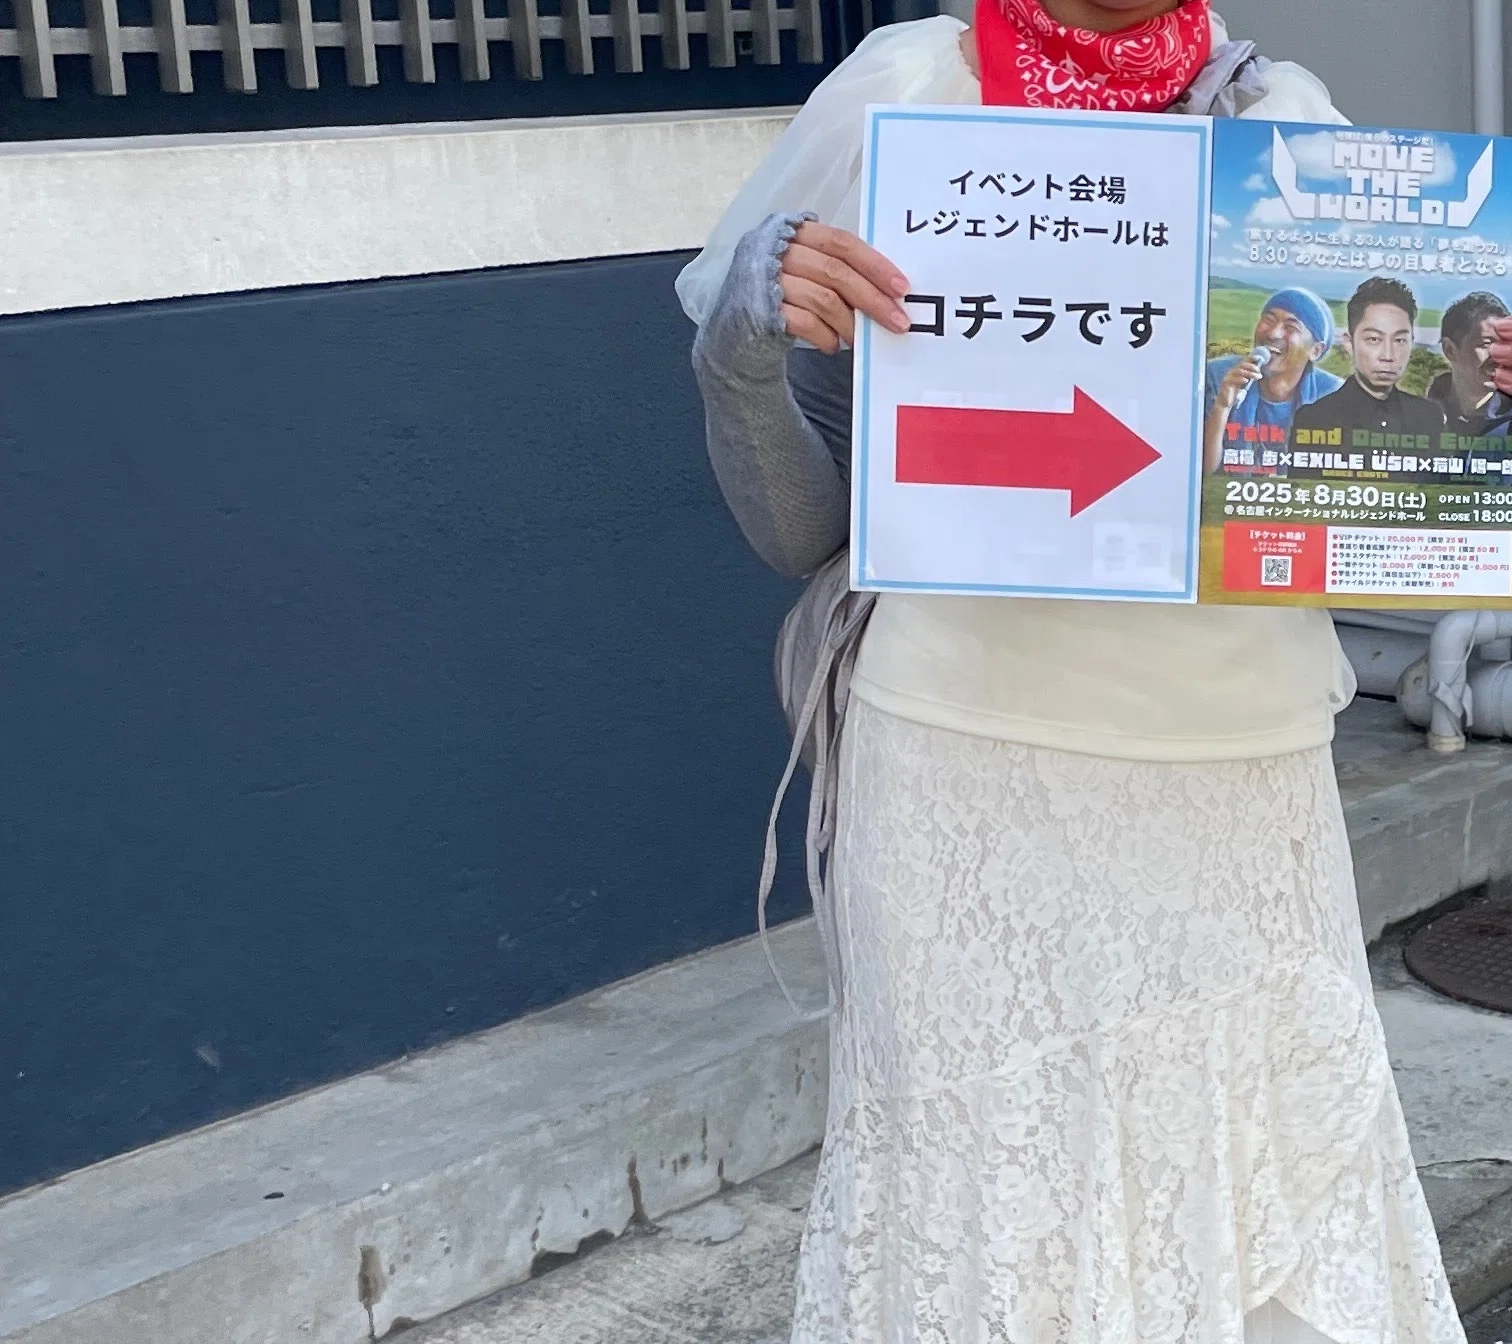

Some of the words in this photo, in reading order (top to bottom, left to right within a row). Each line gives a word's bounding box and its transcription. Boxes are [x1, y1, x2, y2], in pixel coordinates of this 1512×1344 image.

[1334, 142, 1434, 172] MOVE
[948, 170, 1128, 205] イベント会場
[1346, 169, 1421, 197] THE
[1319, 194, 1444, 226] WORLD
[905, 209, 1170, 248] レジェンドホールは
[1249, 246, 1288, 264] 8.30
[904, 293, 1168, 350] コチラです
[1296, 427, 1342, 446] and
[1439, 494, 1470, 504] OPEN
[1439, 512, 1470, 522] CLOSE
